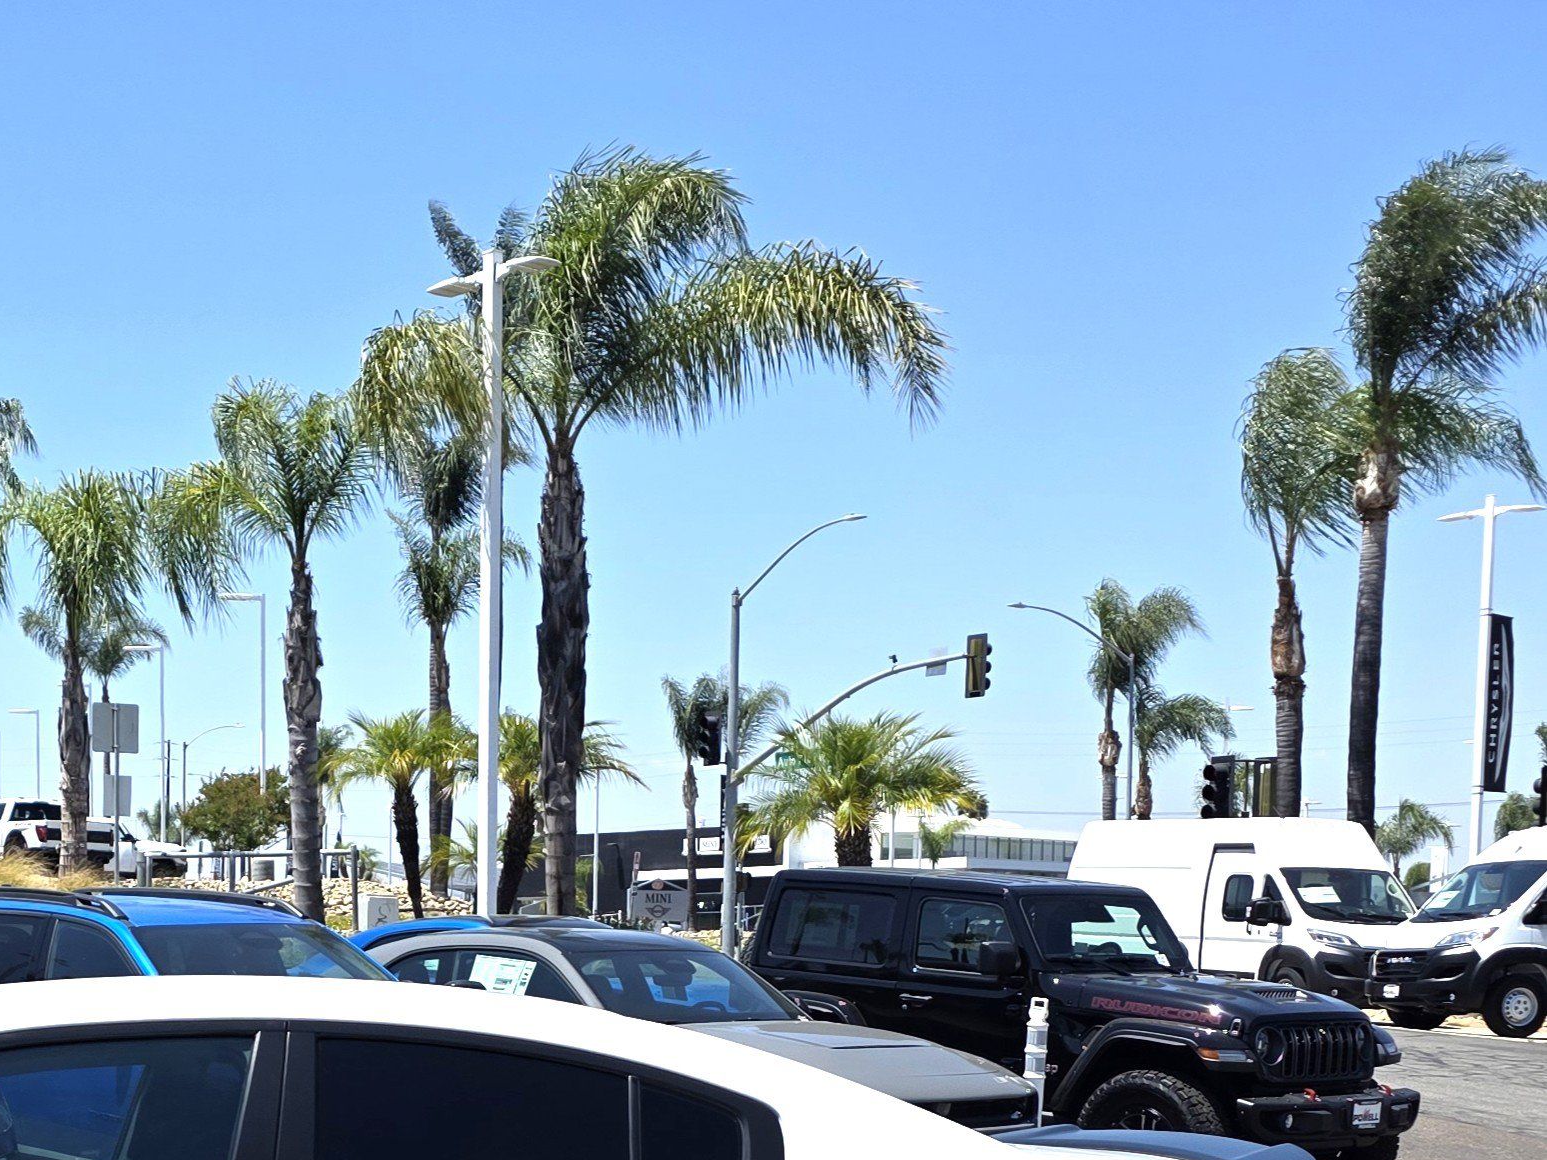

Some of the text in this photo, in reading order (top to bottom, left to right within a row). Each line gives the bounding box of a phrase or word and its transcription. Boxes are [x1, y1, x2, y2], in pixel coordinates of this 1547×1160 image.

[1488, 643, 1500, 763] CHRYSLER
[645, 893, 672, 903] MINI
[1091, 997, 1221, 1025] RUBICON
